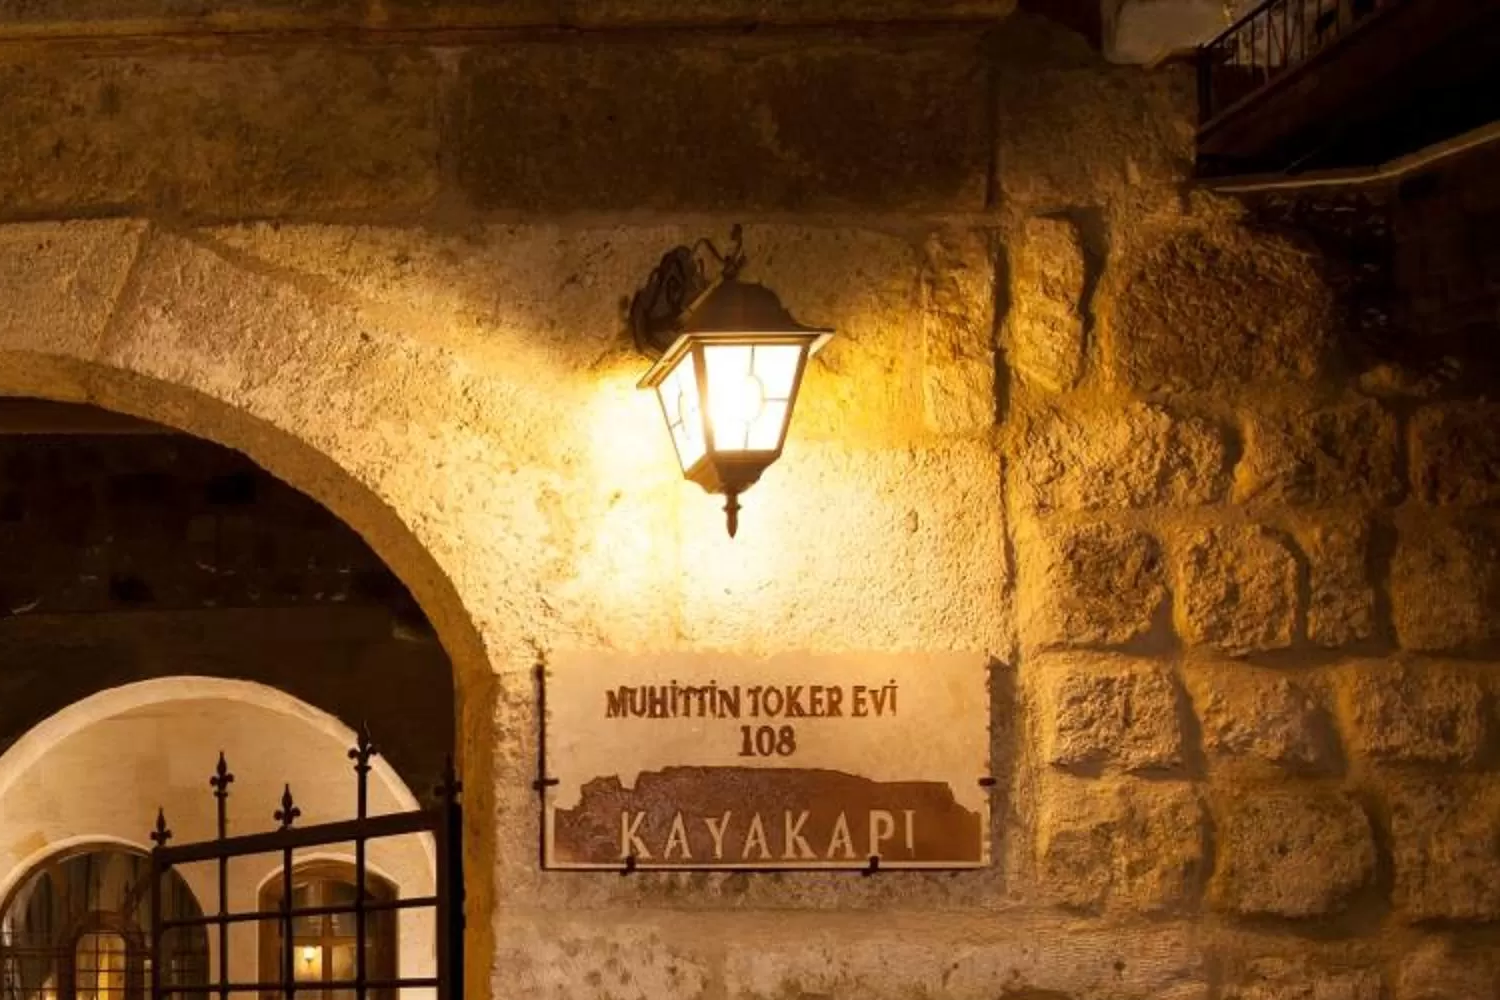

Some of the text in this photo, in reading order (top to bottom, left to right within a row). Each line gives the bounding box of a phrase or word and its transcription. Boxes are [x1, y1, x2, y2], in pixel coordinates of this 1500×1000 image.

[605, 679, 898, 719] MUHİTTİN TOKER EVİ
[738, 725, 797, 757] 108
[619, 809, 916, 859] KAYAKAPI
